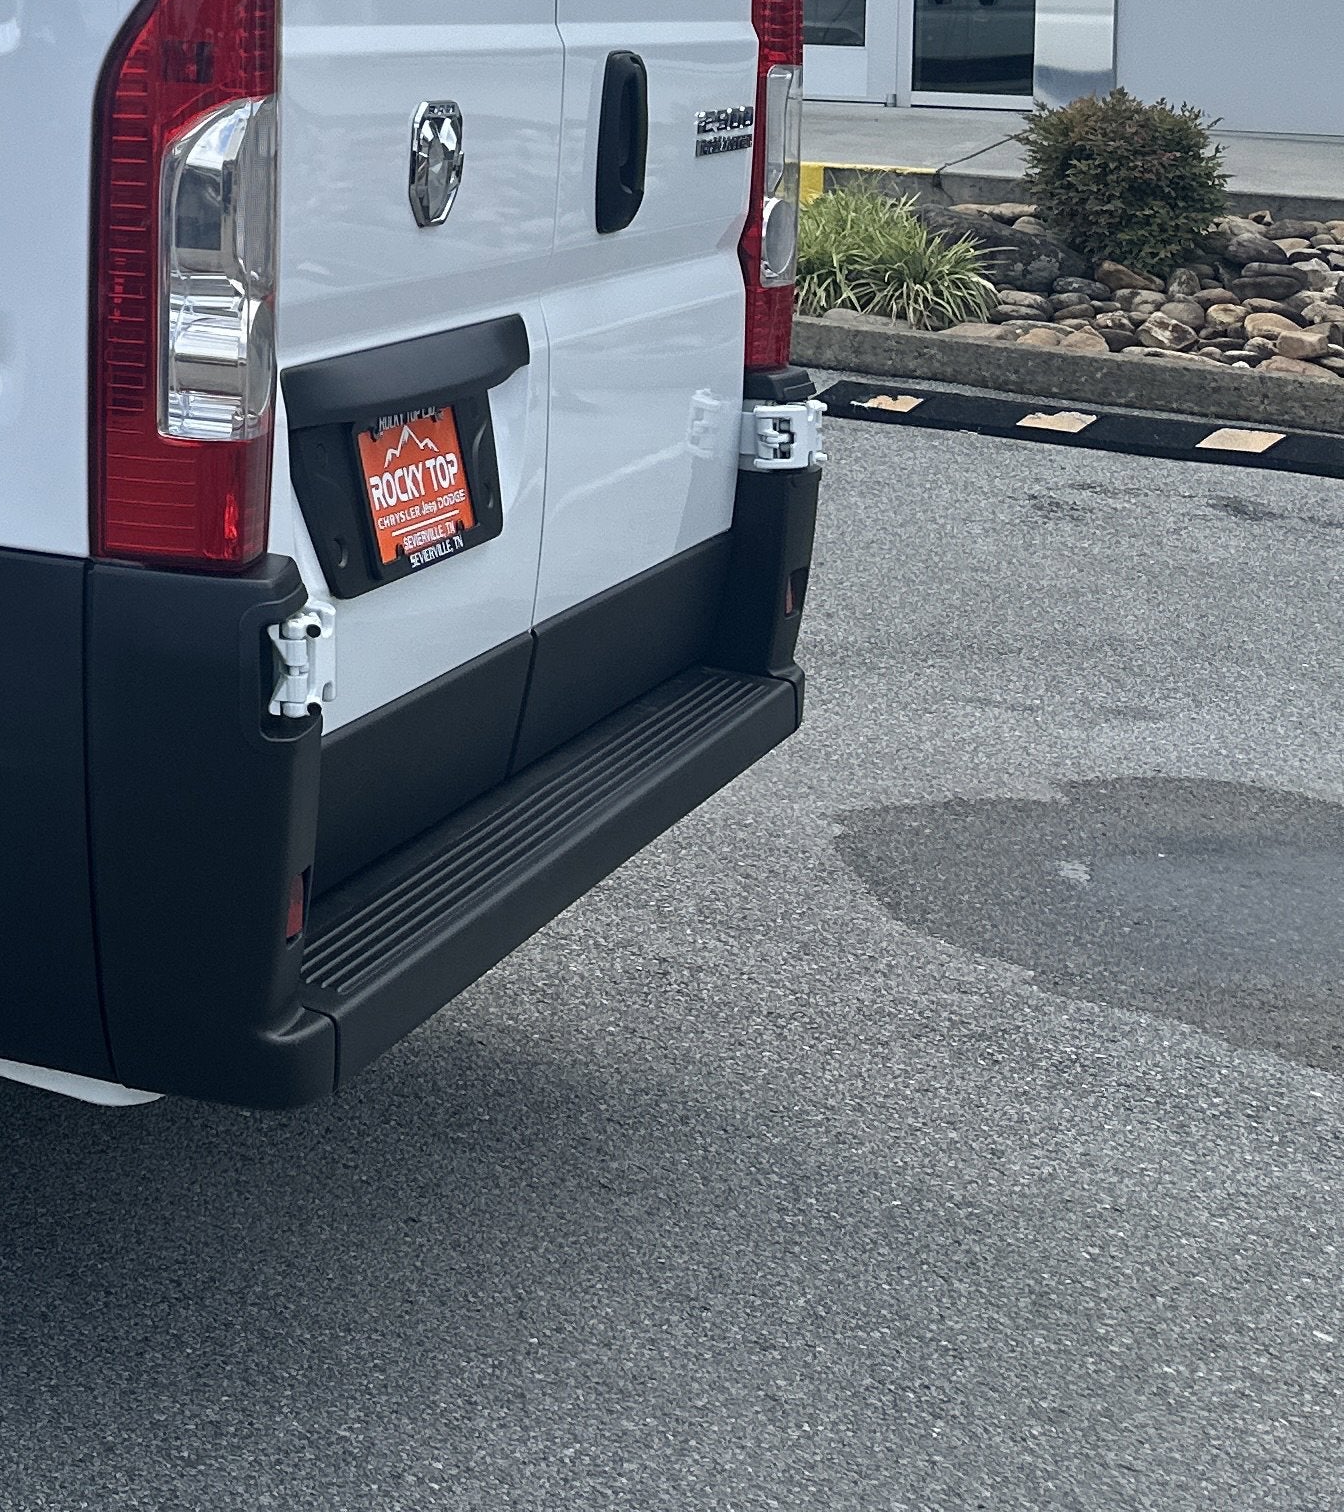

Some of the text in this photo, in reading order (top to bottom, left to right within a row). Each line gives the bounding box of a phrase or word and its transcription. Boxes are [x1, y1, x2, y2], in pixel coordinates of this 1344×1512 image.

[369, 452, 459, 510] ROCKY TOP
[377, 489, 466, 530] CHRYSLER Jeep DODGE
[452, 534, 464, 549] TN
